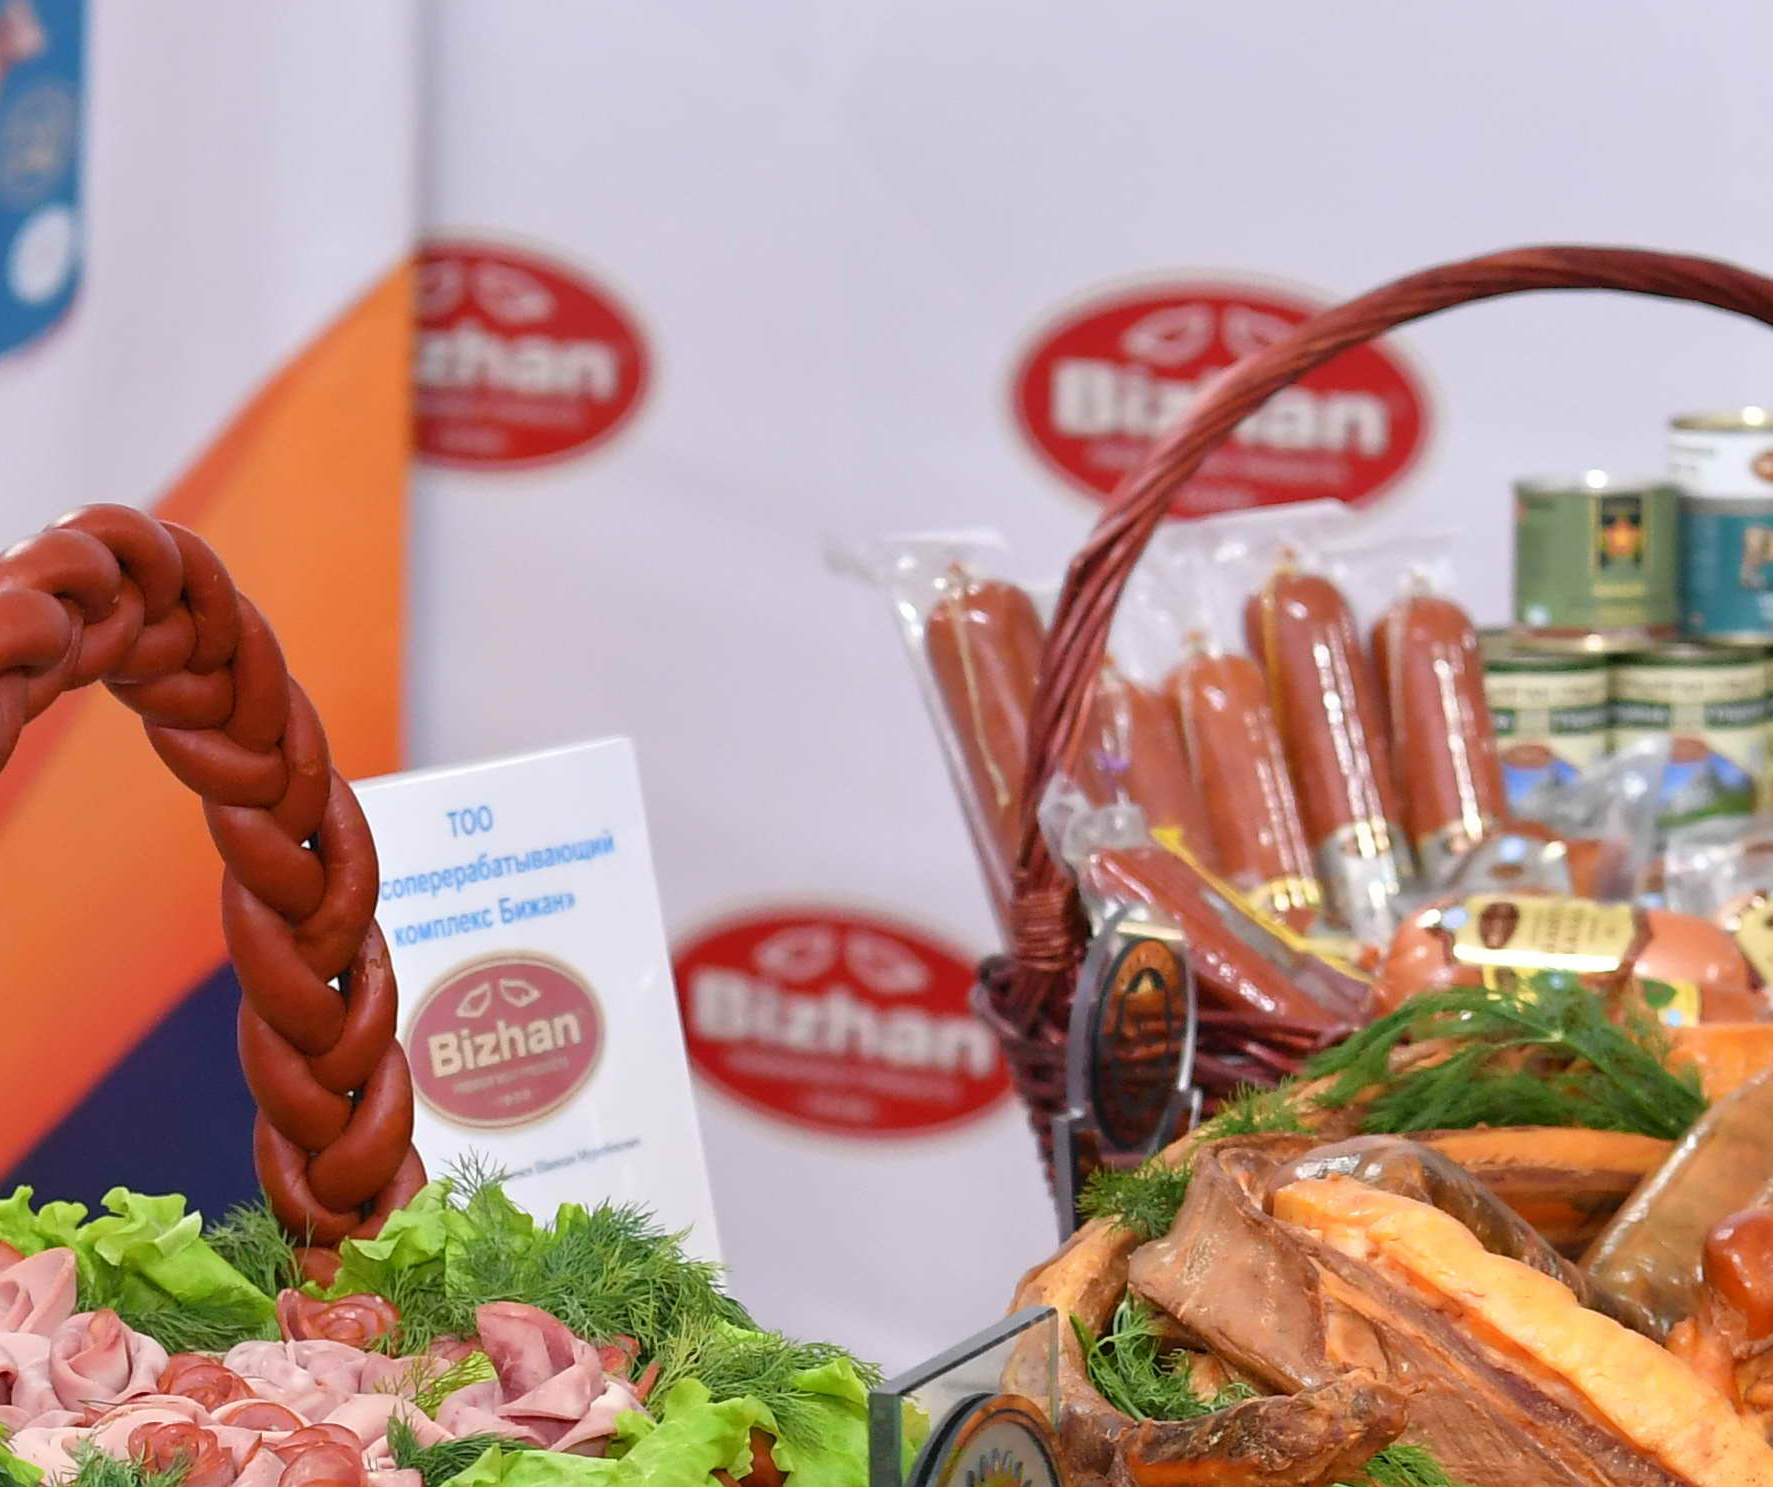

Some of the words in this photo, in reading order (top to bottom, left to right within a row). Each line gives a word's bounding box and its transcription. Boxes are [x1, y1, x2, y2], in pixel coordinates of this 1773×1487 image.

[444, 803, 494, 839] ТОО
[380, 828, 616, 901] соперерабатывающий
[394, 903, 493, 949] комплекс
[428, 1011, 582, 1080] Bizhan
[687, 965, 999, 1080] Bizhan
